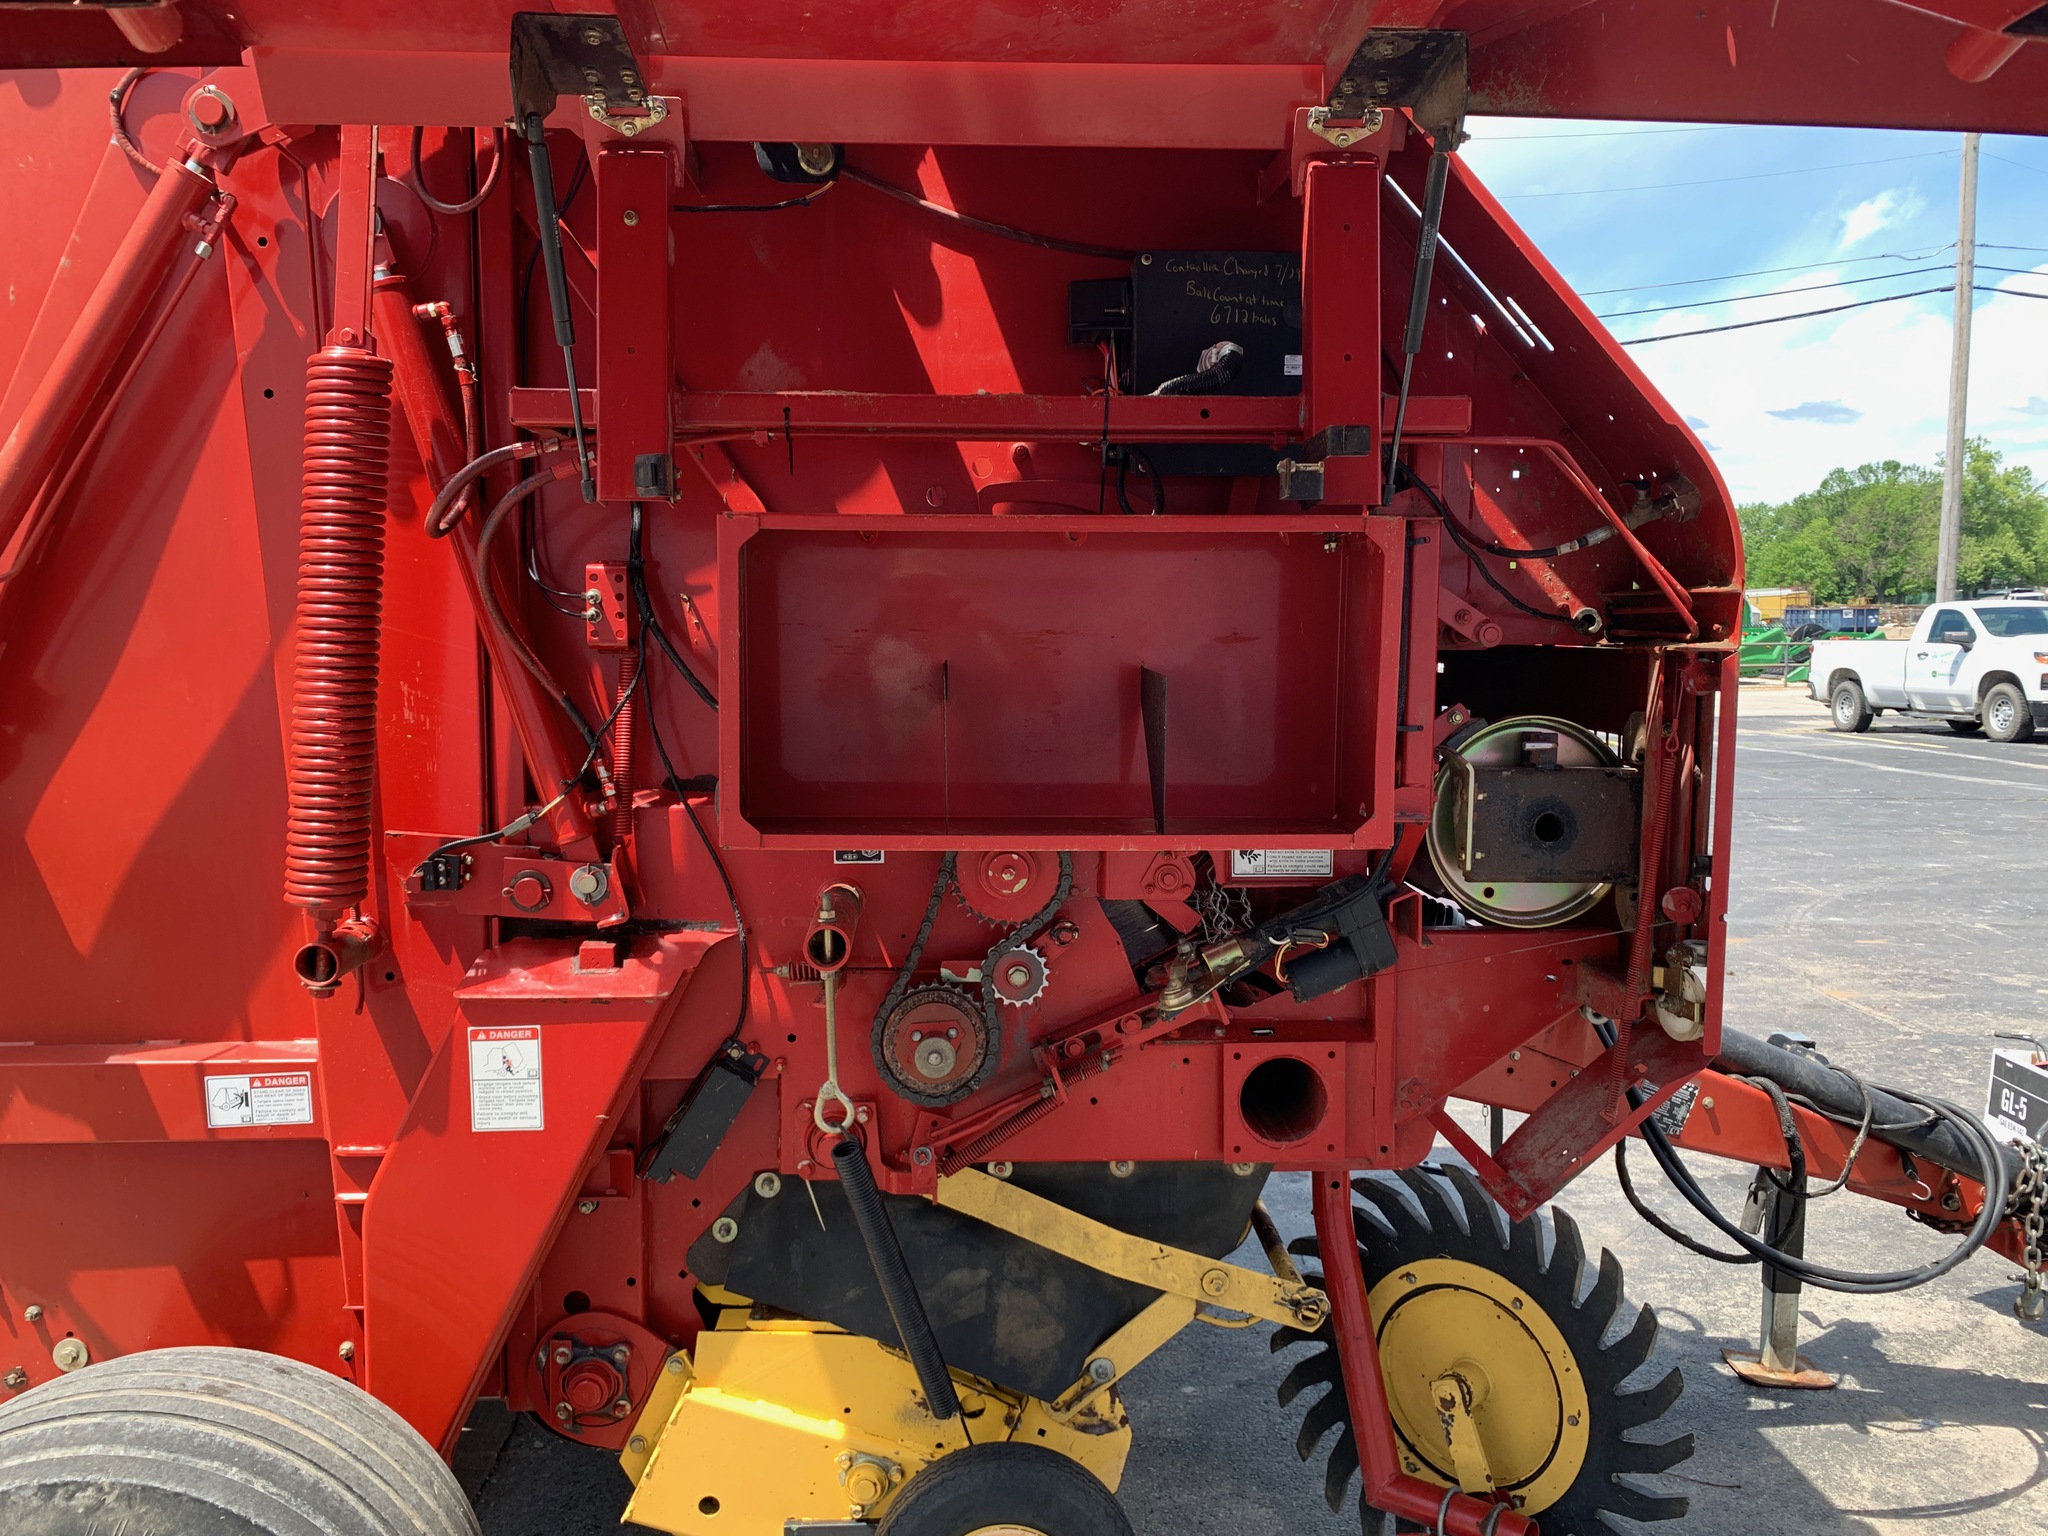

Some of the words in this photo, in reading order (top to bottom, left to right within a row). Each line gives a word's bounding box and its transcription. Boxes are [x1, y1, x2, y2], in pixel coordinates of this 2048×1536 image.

[1245, 293, 1257, 305] at
[1210, 304, 1249, 324] 6712
[490, 1030, 532, 1039] DANGER
[264, 1076, 306, 1086] DANGER
[2001, 1088, 2028, 1121] GL-5
[1999, 1117, 2008, 1128] SAE
